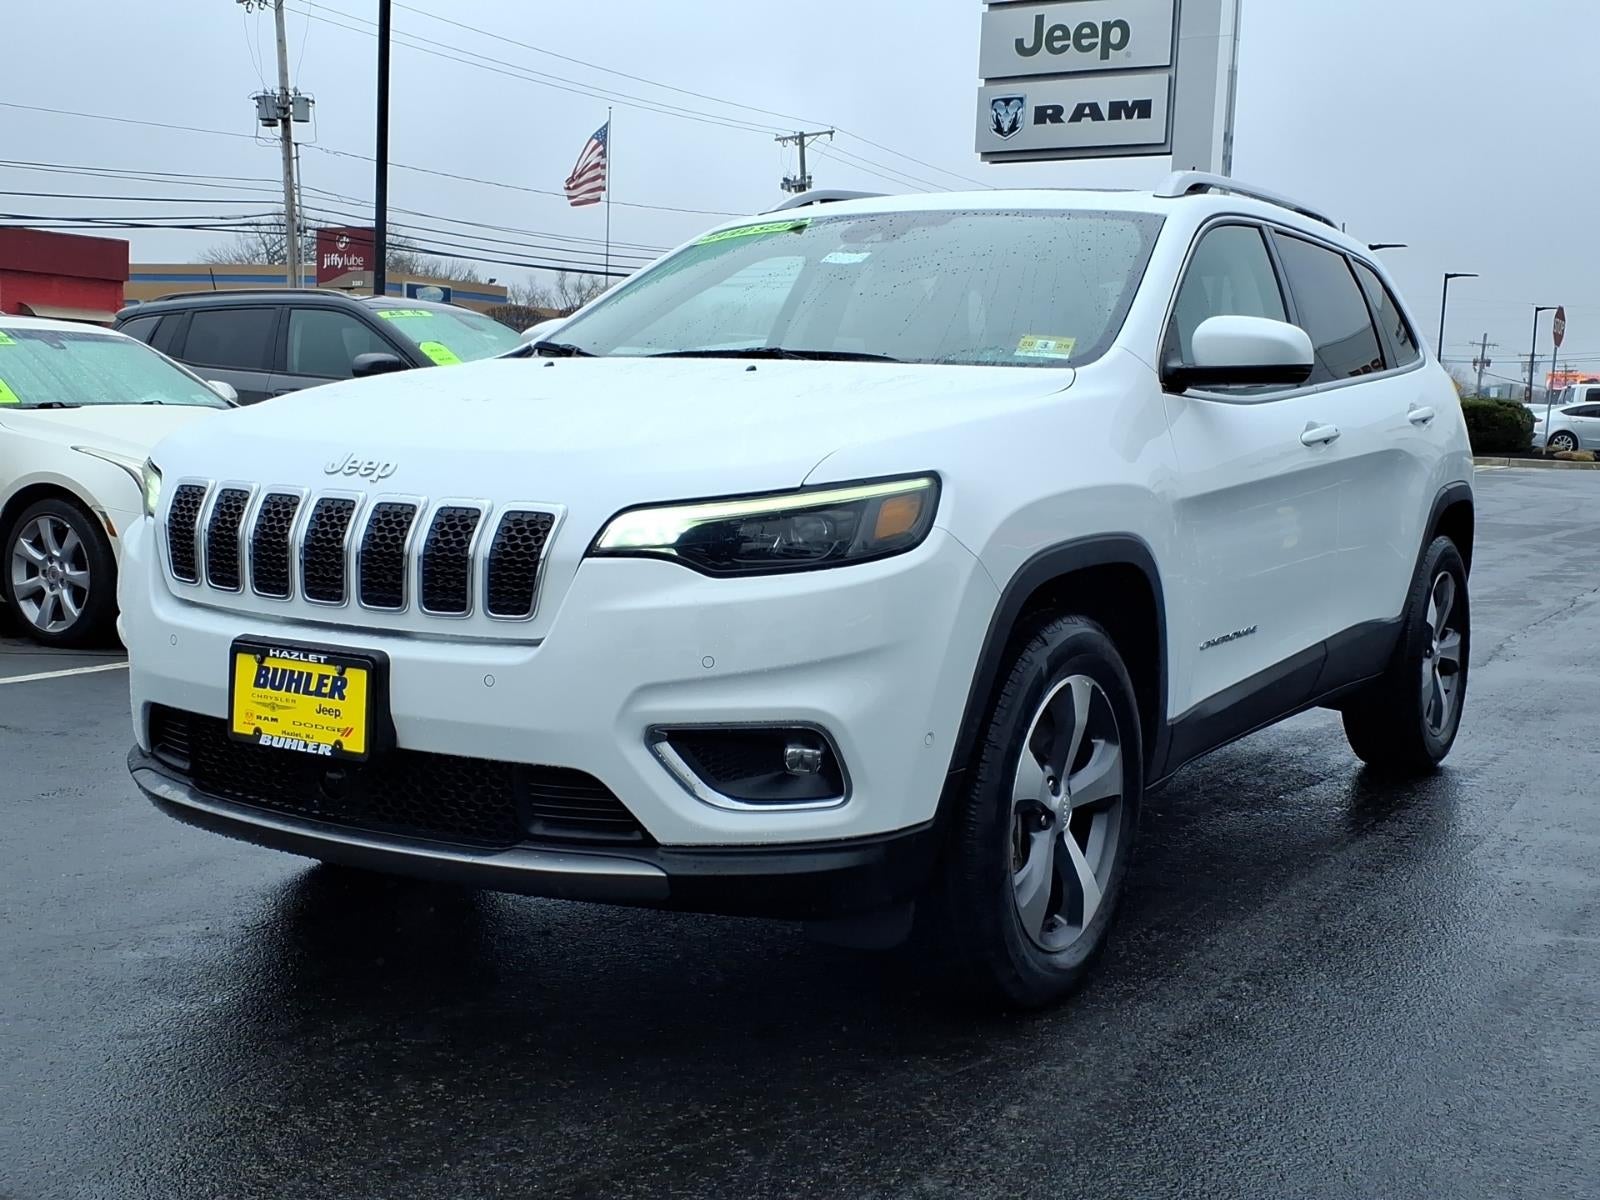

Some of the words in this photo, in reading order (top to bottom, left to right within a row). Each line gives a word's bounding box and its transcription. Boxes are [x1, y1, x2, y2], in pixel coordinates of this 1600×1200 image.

[1014, 13, 1131, 61] Jeep
[1033, 98, 1153, 126] RAM
[323, 452, 399, 484] Jeep
[269, 649, 328, 664] HAZLET
[253, 665, 349, 702] BUHLER
[251, 692, 297, 704] CHRYSLER
[255, 714, 279, 723] RAM
[315, 703, 342, 719] Jeep
[292, 720, 345, 733] DODGE
[259, 733, 333, 756] BUHLER
